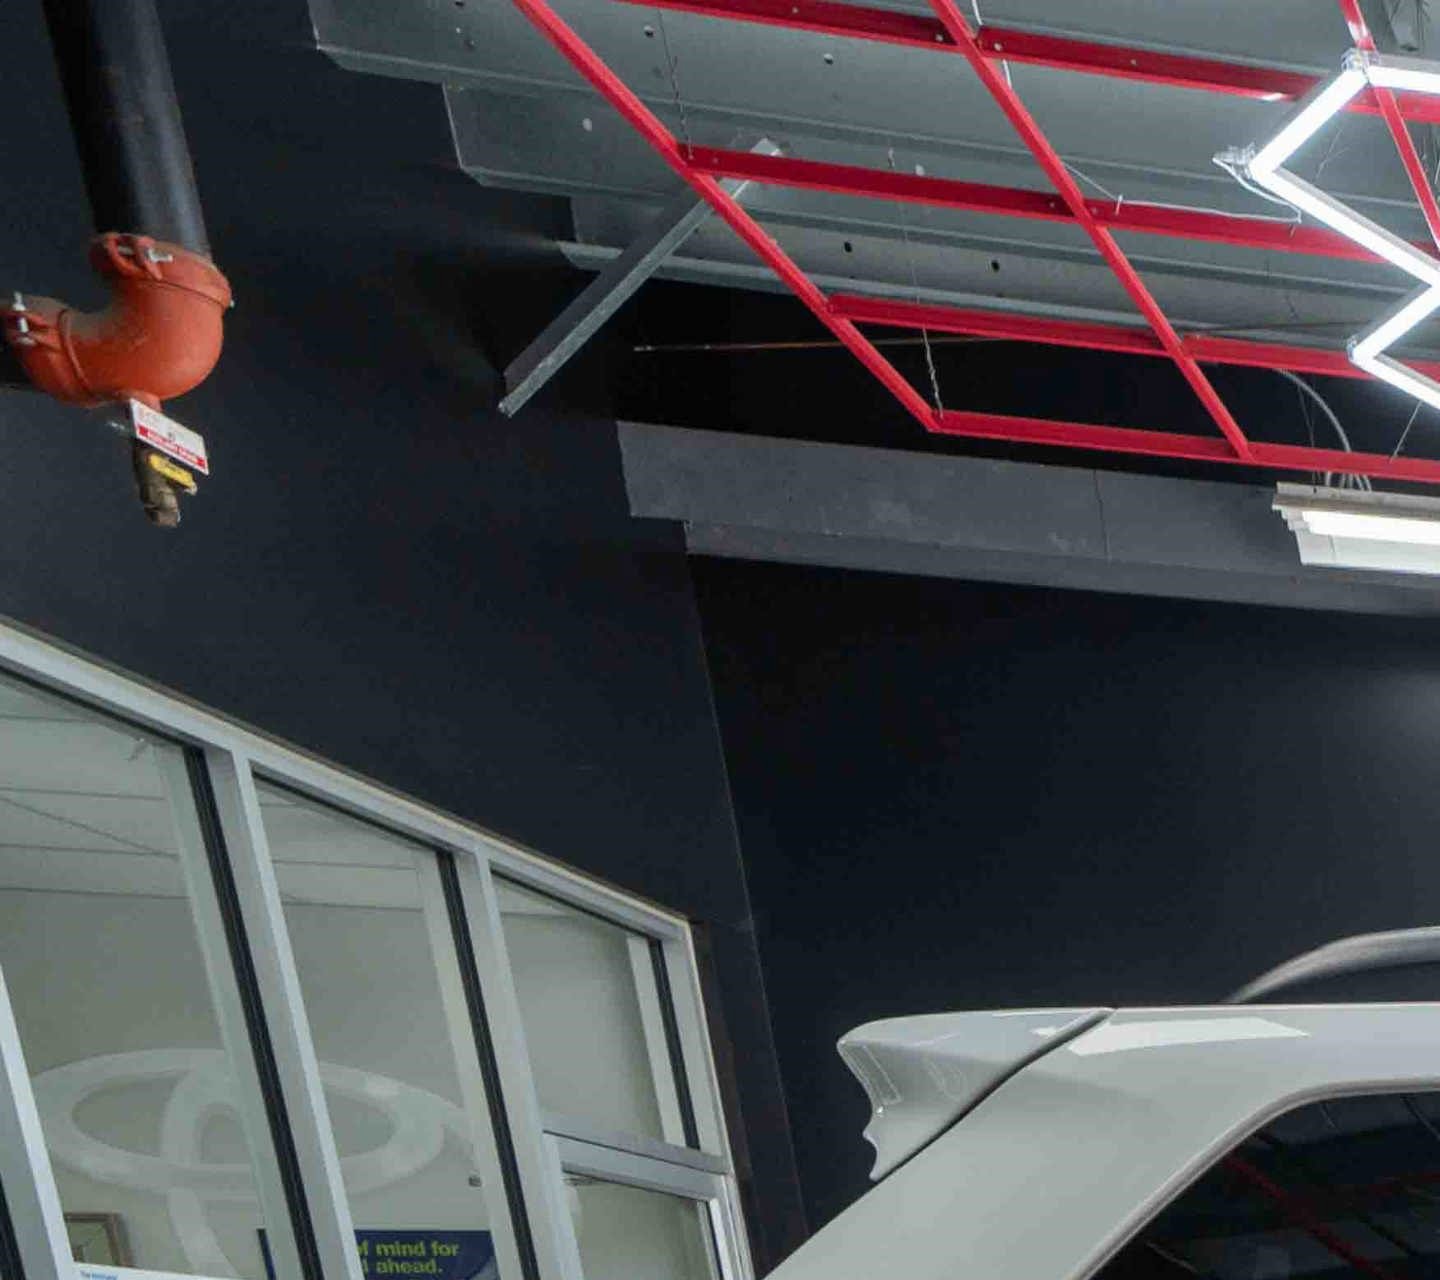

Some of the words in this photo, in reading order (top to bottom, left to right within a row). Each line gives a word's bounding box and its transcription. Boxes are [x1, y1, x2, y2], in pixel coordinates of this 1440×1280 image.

[375, 1241, 426, 1256] mind
[430, 1240, 459, 1257] for
[376, 1259, 443, 1274] ahead.
